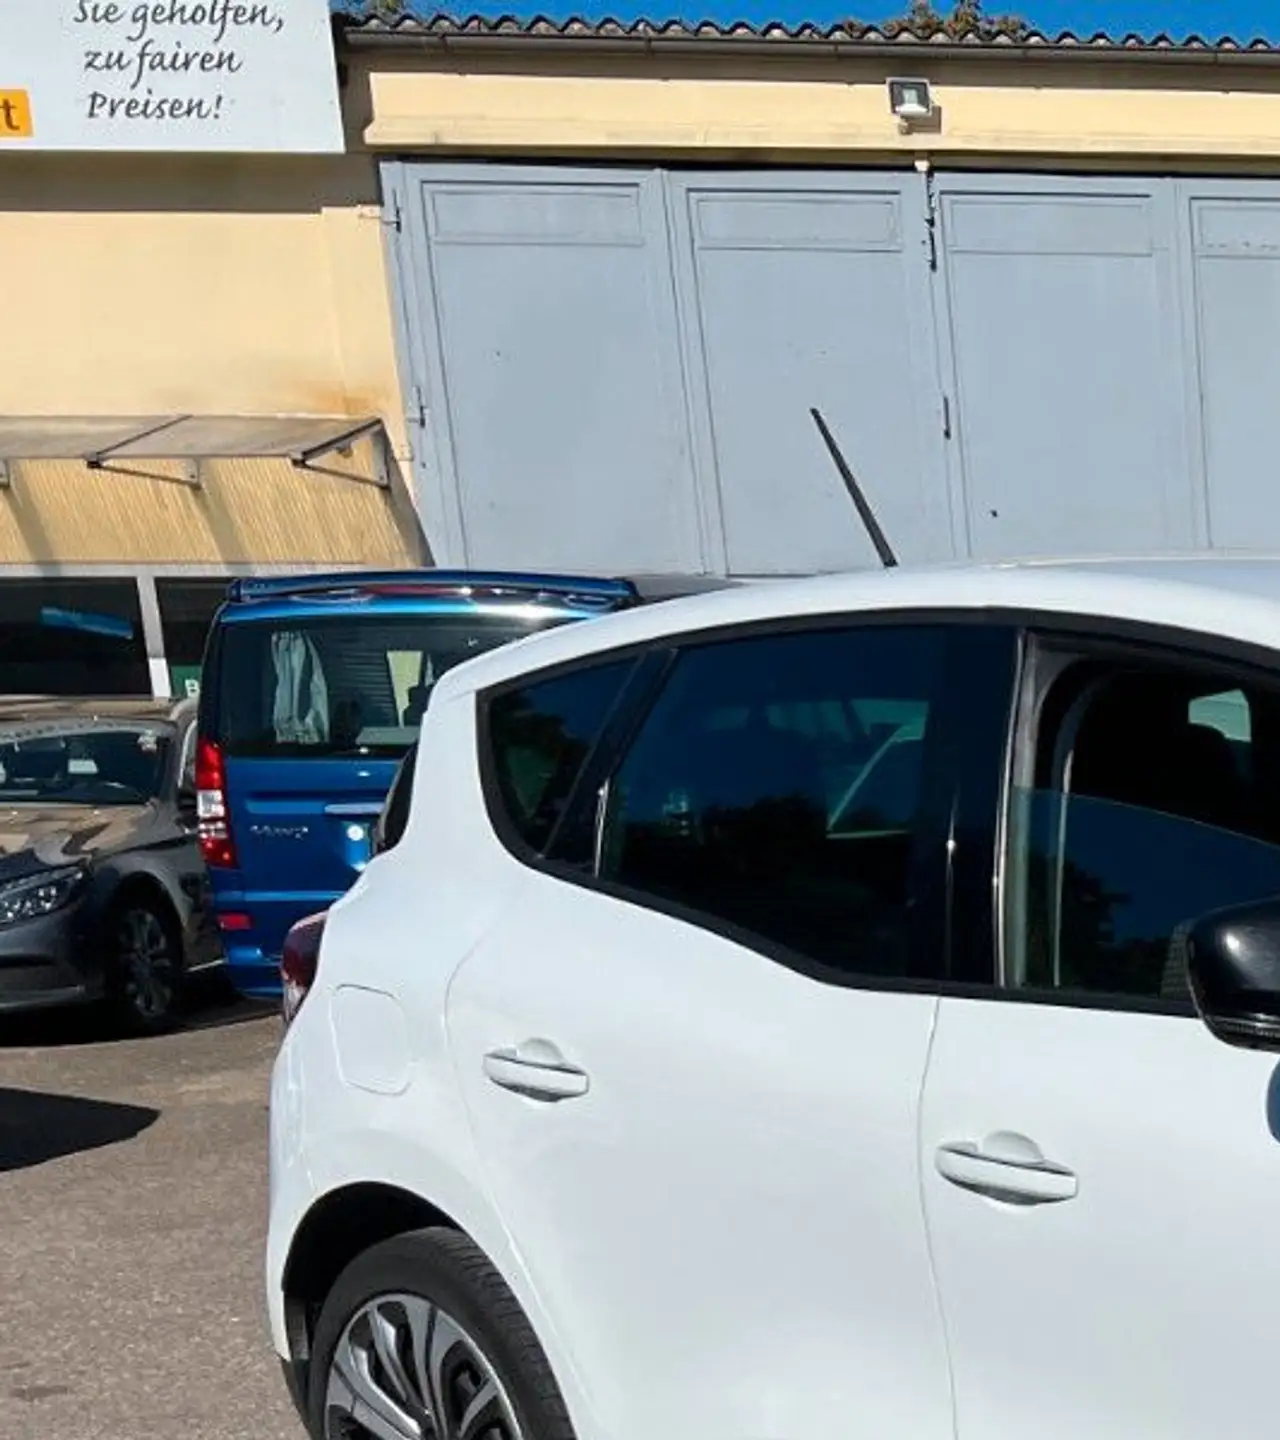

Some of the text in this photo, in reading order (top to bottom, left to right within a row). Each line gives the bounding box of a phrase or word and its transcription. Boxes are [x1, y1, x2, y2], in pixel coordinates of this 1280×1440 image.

[73, 0, 284, 43] Sie geholfen,
[84, 38, 243, 89] zu fairen
[87, 88, 222, 119] Preisen!
